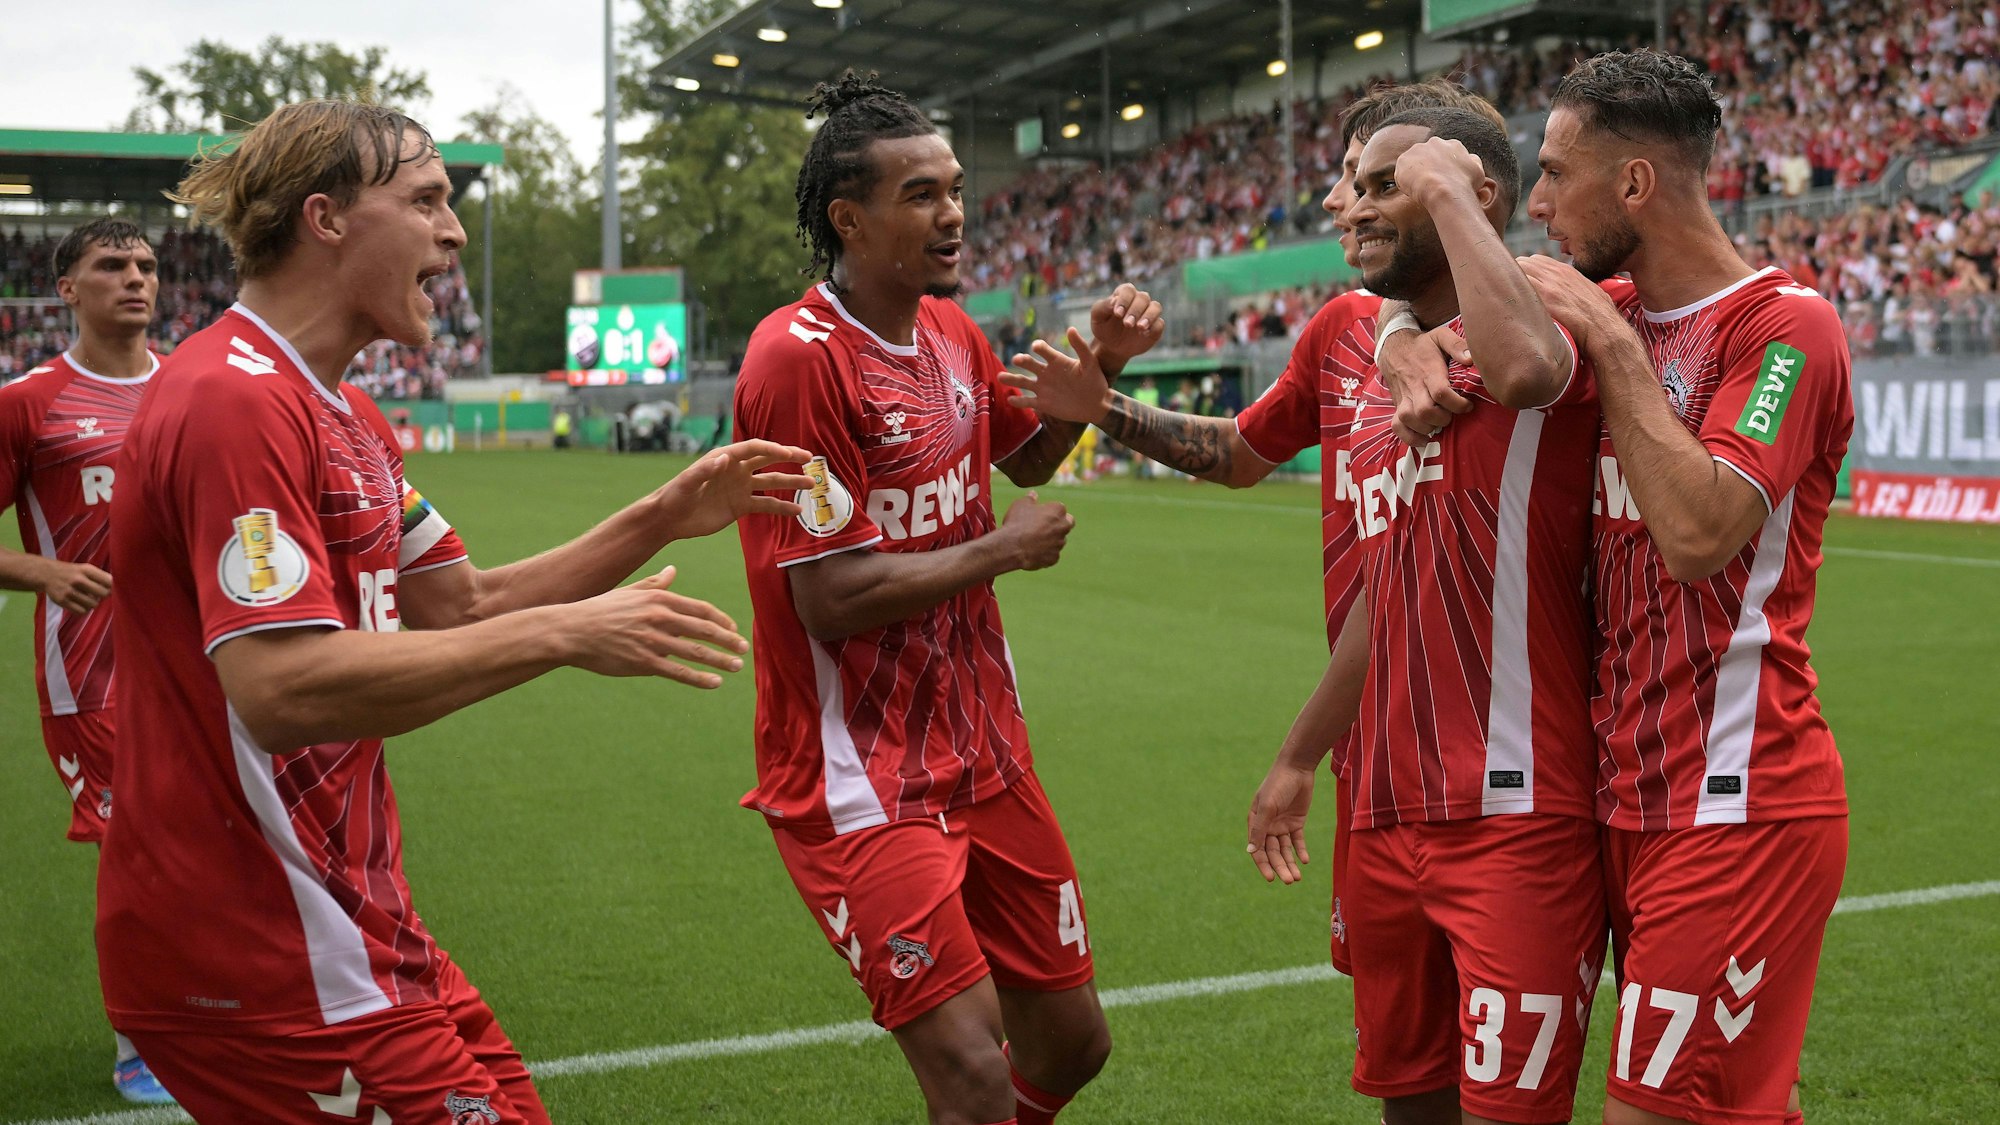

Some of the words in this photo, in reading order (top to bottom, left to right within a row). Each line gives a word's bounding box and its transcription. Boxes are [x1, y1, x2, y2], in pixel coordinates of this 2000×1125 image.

[1747, 353, 1795, 434] DEVK
[1058, 879, 1087, 956] 4
[1465, 987, 1563, 1090] 37
[1615, 983, 1699, 1089] 17
